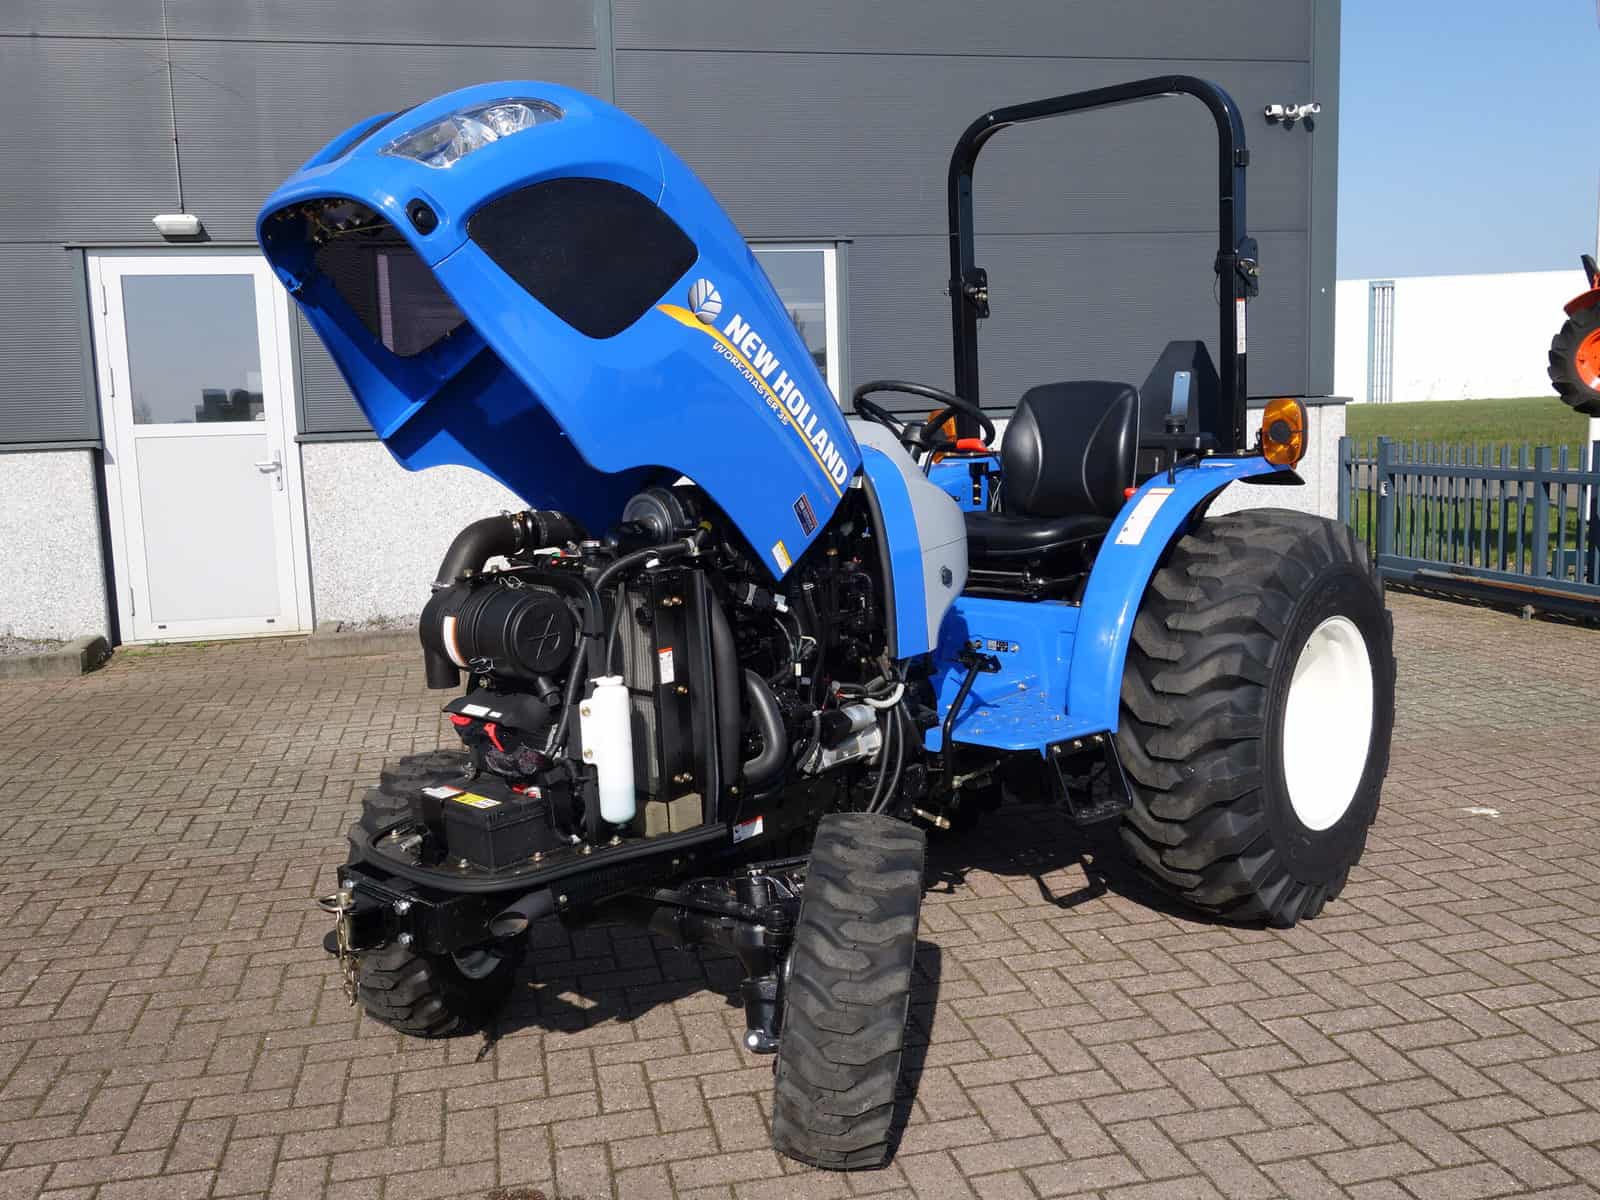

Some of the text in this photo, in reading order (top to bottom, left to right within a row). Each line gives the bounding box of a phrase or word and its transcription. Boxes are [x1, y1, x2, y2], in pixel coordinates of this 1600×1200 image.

[712, 342, 778, 412] WORKMASTER
[723, 314, 848, 485] NEW HOLLAND
